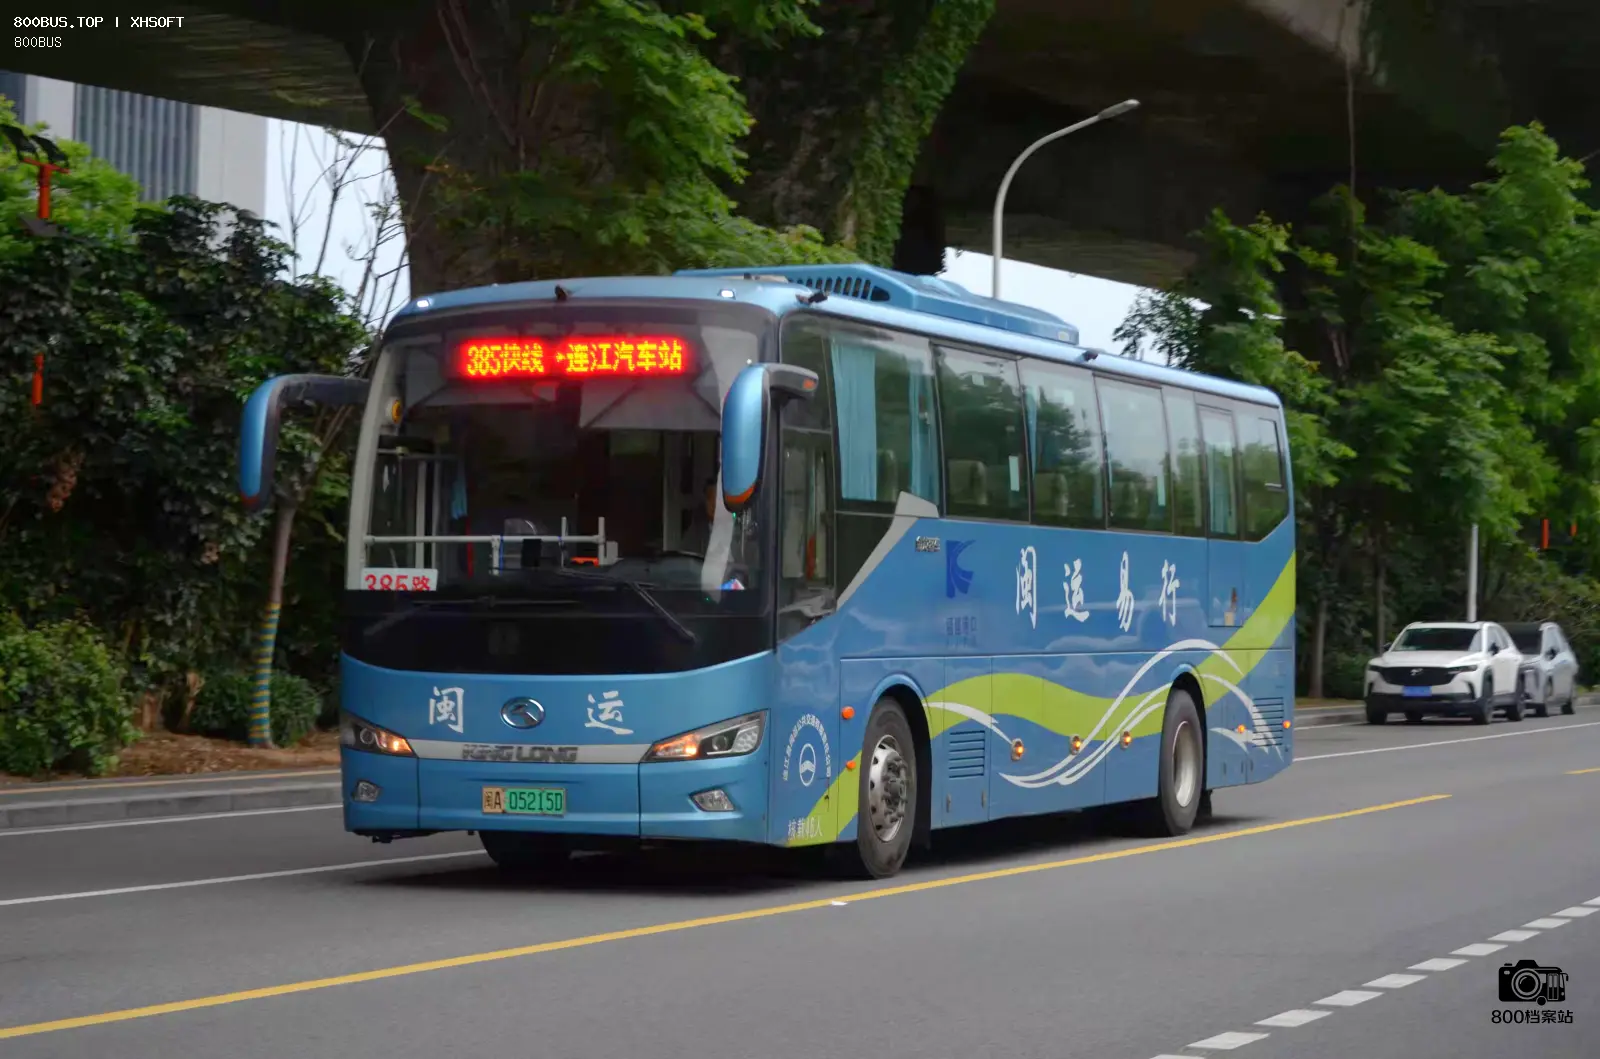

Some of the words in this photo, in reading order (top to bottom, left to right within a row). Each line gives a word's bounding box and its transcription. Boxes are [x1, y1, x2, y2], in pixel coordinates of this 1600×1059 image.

[1016, 545, 1180, 633] 闽运易行
[428, 686, 465, 734] 闽
[584, 690, 635, 735] 运
[461, 744, 515, 761] KING
[516, 746, 579, 763] LONG
